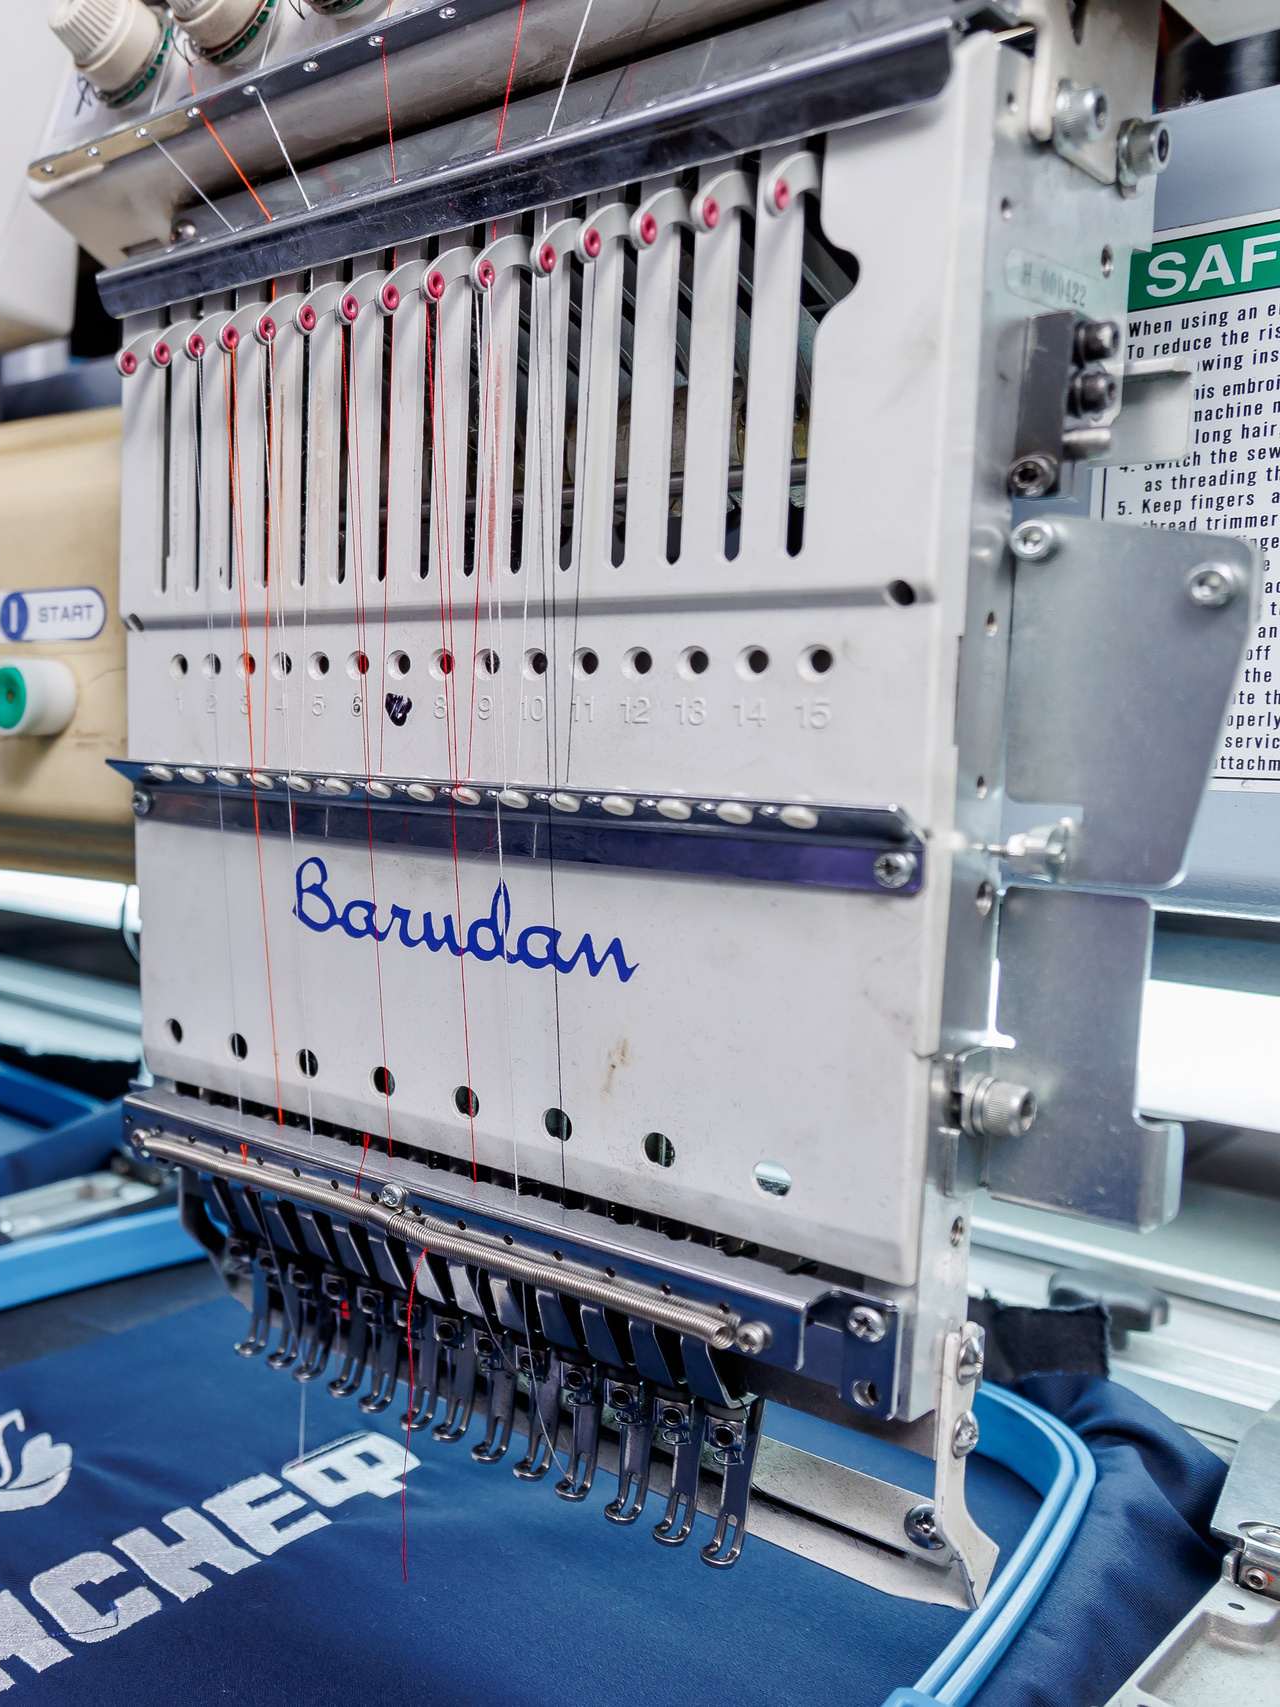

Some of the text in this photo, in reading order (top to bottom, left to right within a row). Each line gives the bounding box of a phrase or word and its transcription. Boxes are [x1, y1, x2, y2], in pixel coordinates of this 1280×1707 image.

[1128, 319, 1173, 339] When
[1181, 310, 1229, 328] using
[1237, 306, 1258, 321] an
[1127, 344, 1145, 360] To
[1153, 335, 1212, 357] reduce
[1221, 329, 1250, 347] the
[1197, 353, 1244, 371] wing
[1195, 428, 1233, 445] long
[1210, 448, 1238, 465] the
[1144, 479, 1163, 493] as
[1171, 469, 1257, 490] threading
[1117, 500, 1133, 516] 5.
[1141, 498, 1182, 515] Keep
[1191, 493, 1255, 512] fingers
[1206, 514, 1279, 531] trimmer
[38, 603, 95, 624] START
[1244, 667, 1272, 683] the
[311, 693, 325, 717] 5
[433, 694, 447, 720] 8
[477, 694, 493, 721] 9
[521, 695, 546, 722] 10
[571, 695, 595, 723] 11
[620, 696, 651, 725] 12
[675, 696, 708, 726] 13
[732, 697, 767, 728] 14
[795, 698, 832, 730] 15
[292, 856, 639, 983] Barudan
